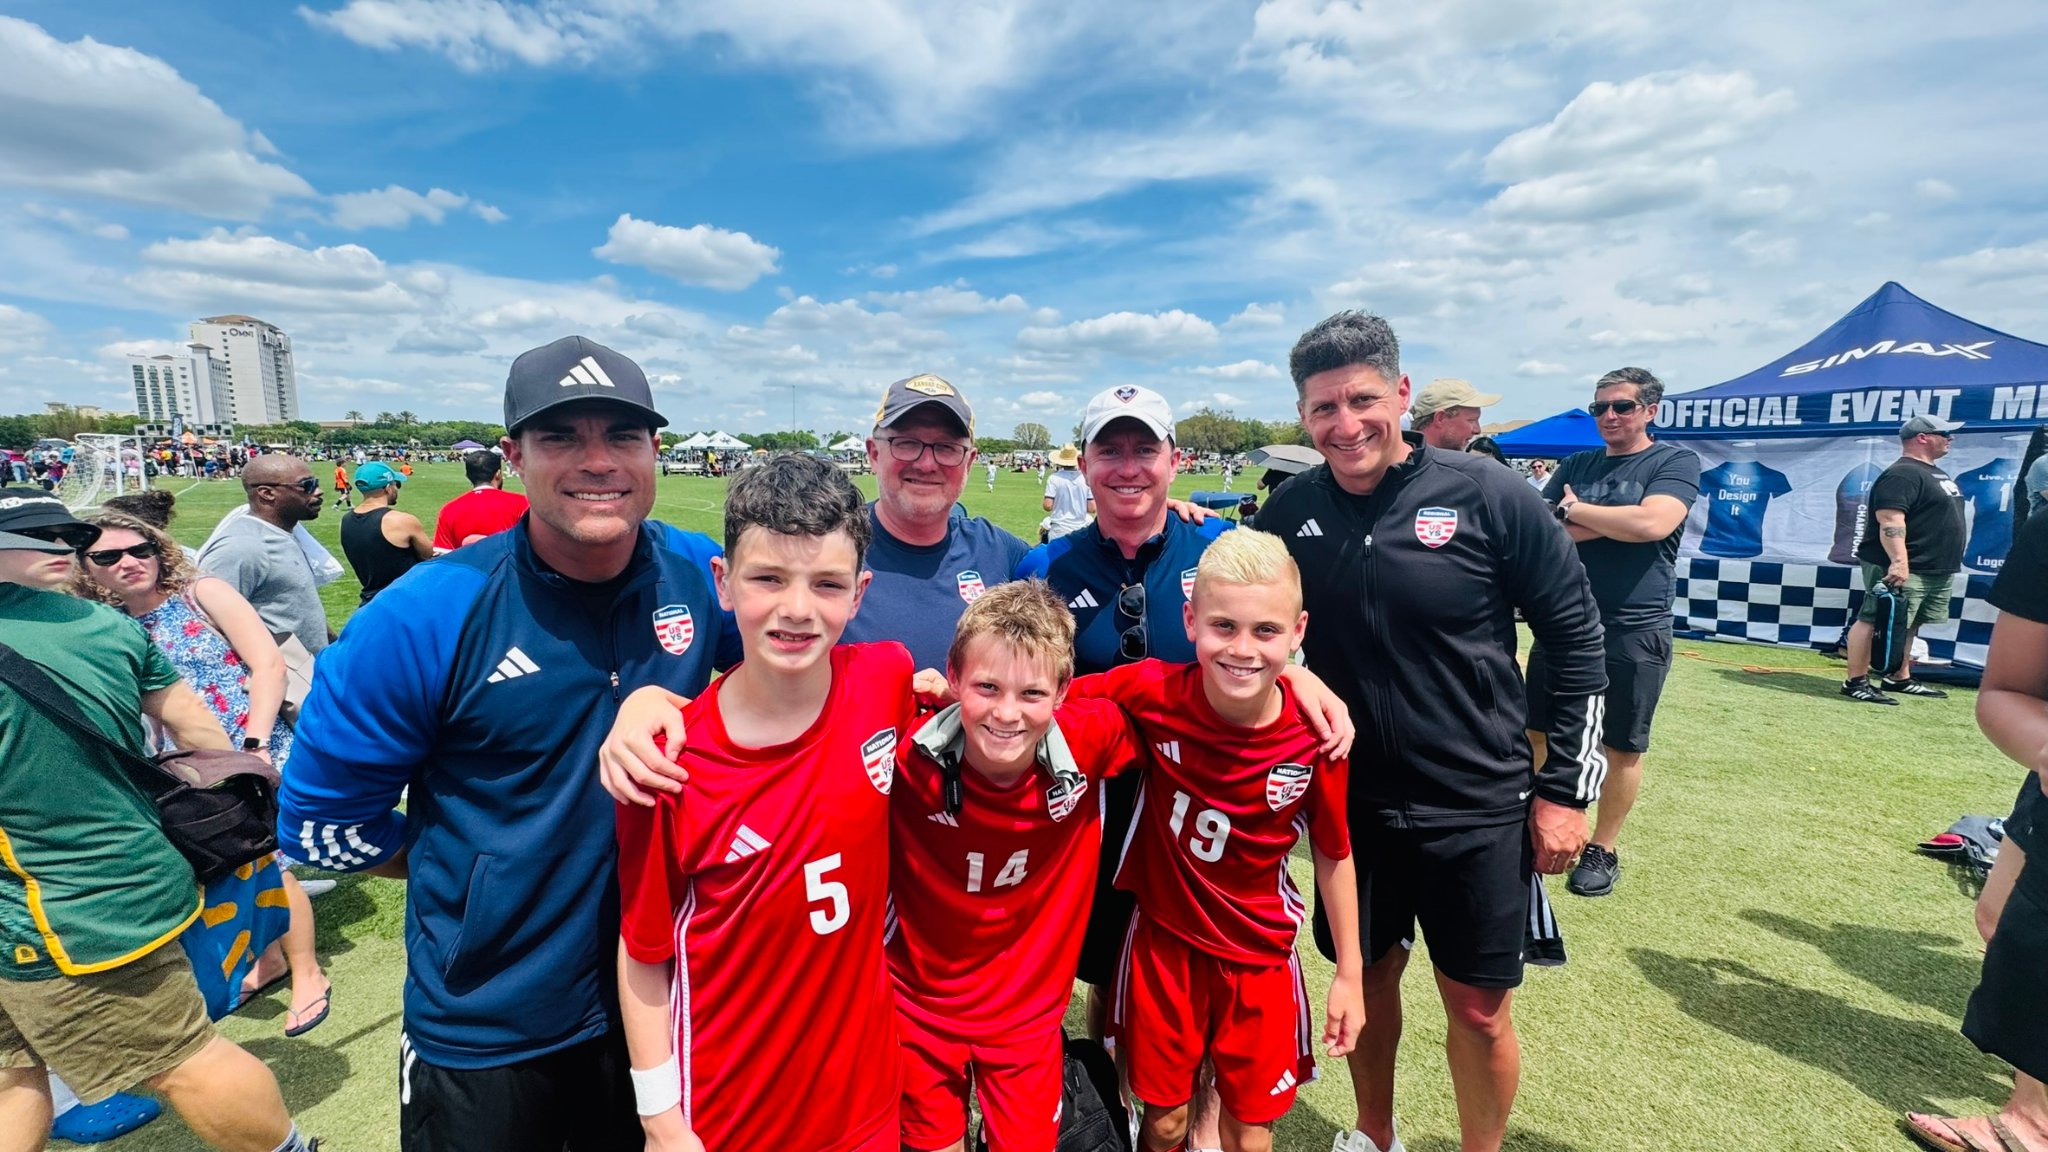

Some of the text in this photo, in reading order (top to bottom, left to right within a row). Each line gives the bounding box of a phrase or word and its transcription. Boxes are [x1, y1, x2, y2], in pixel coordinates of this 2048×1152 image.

[1778, 340, 1996, 377] SIMAX
[1653, 395, 1801, 428] OFFICIAL
[1829, 388, 1962, 424] EVENT
[1729, 473, 1750, 486] You
[1718, 489, 1757, 503] Design
[1731, 504, 1740, 516] It
[669, 625, 681, 635] US
[670, 633, 682, 642] YS
[1169, 790, 1231, 862] 19
[966, 849, 1029, 893] 14
[804, 852, 850, 935] 5
